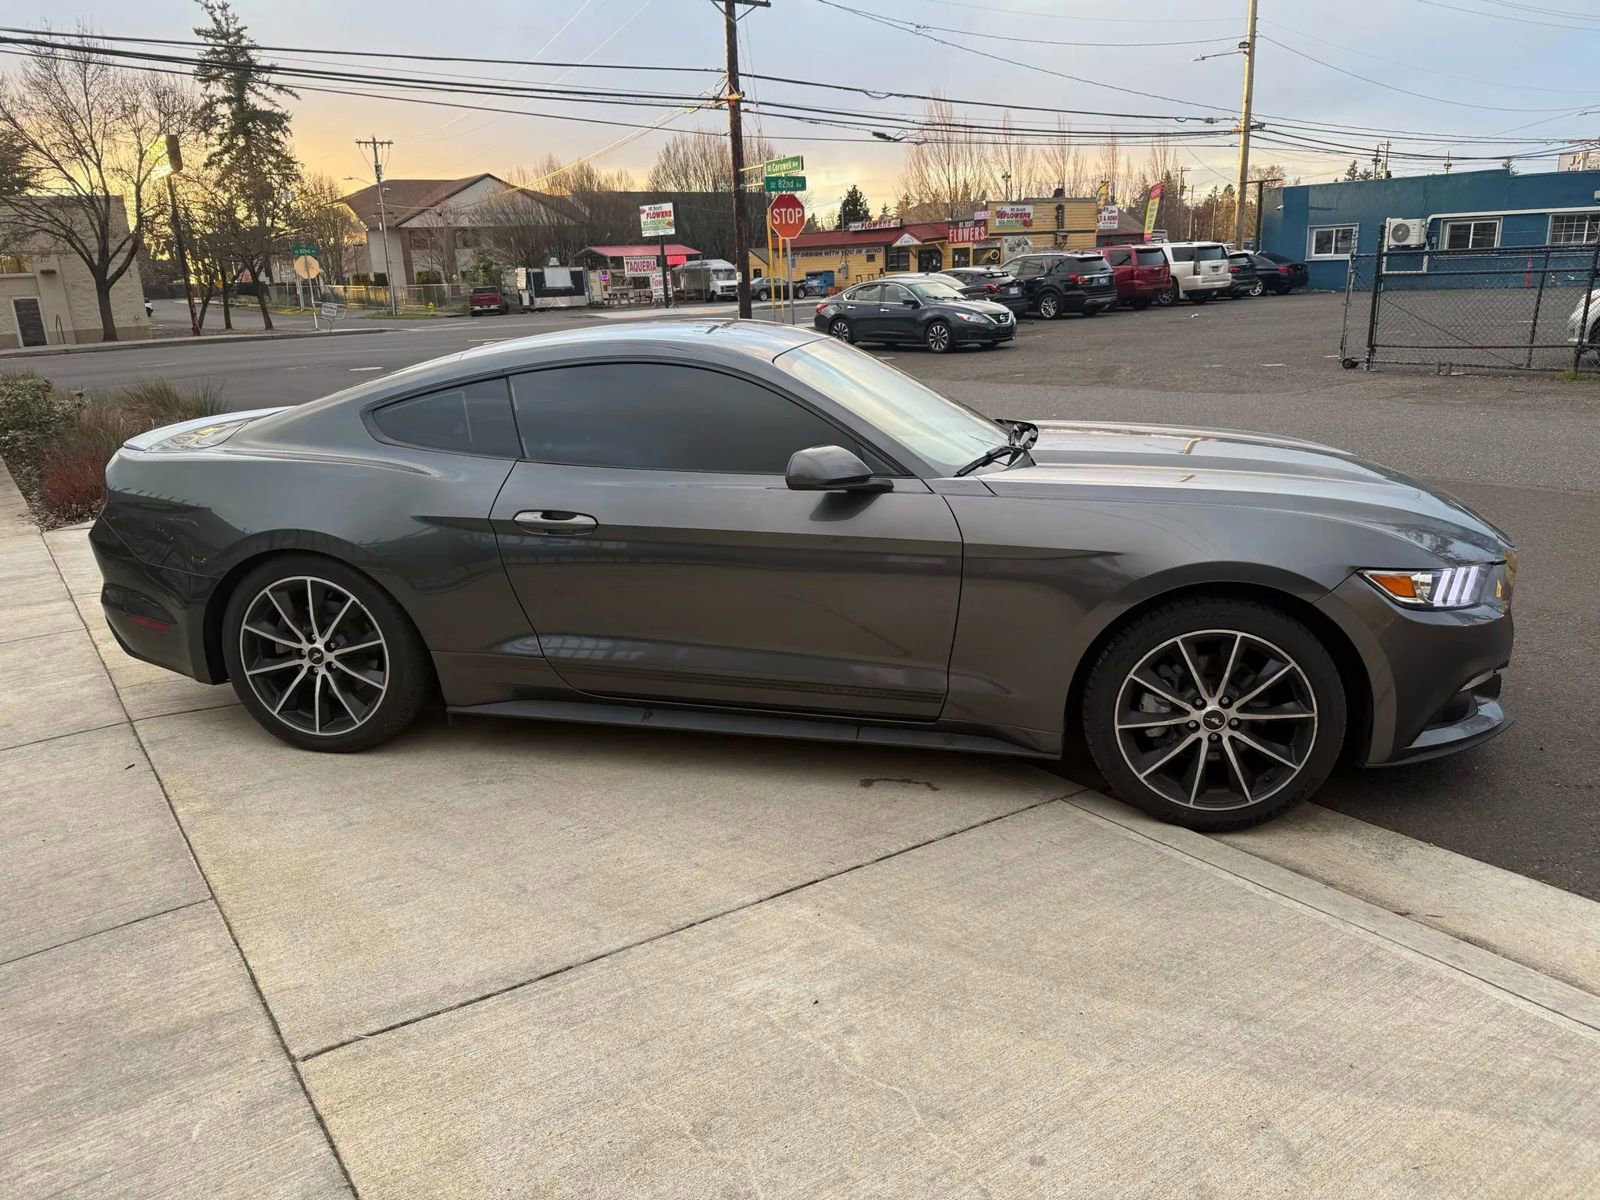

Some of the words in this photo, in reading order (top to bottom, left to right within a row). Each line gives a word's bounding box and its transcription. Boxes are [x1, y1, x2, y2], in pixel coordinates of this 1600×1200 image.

[777, 178, 794, 189] 82nd
[646, 209, 672, 220] FLOWERS
[772, 208, 803, 225] STOP
[1003, 211, 1031, 219] FLOWERS
[860, 220, 891, 230] FLOWERS
[949, 226, 985, 243] FLOWERS
[801, 250, 823, 258] DESIGN
[824, 249, 840, 257] WITH
[841, 248, 854, 257] YOU
[625, 260, 657, 273] TAQUERIA
